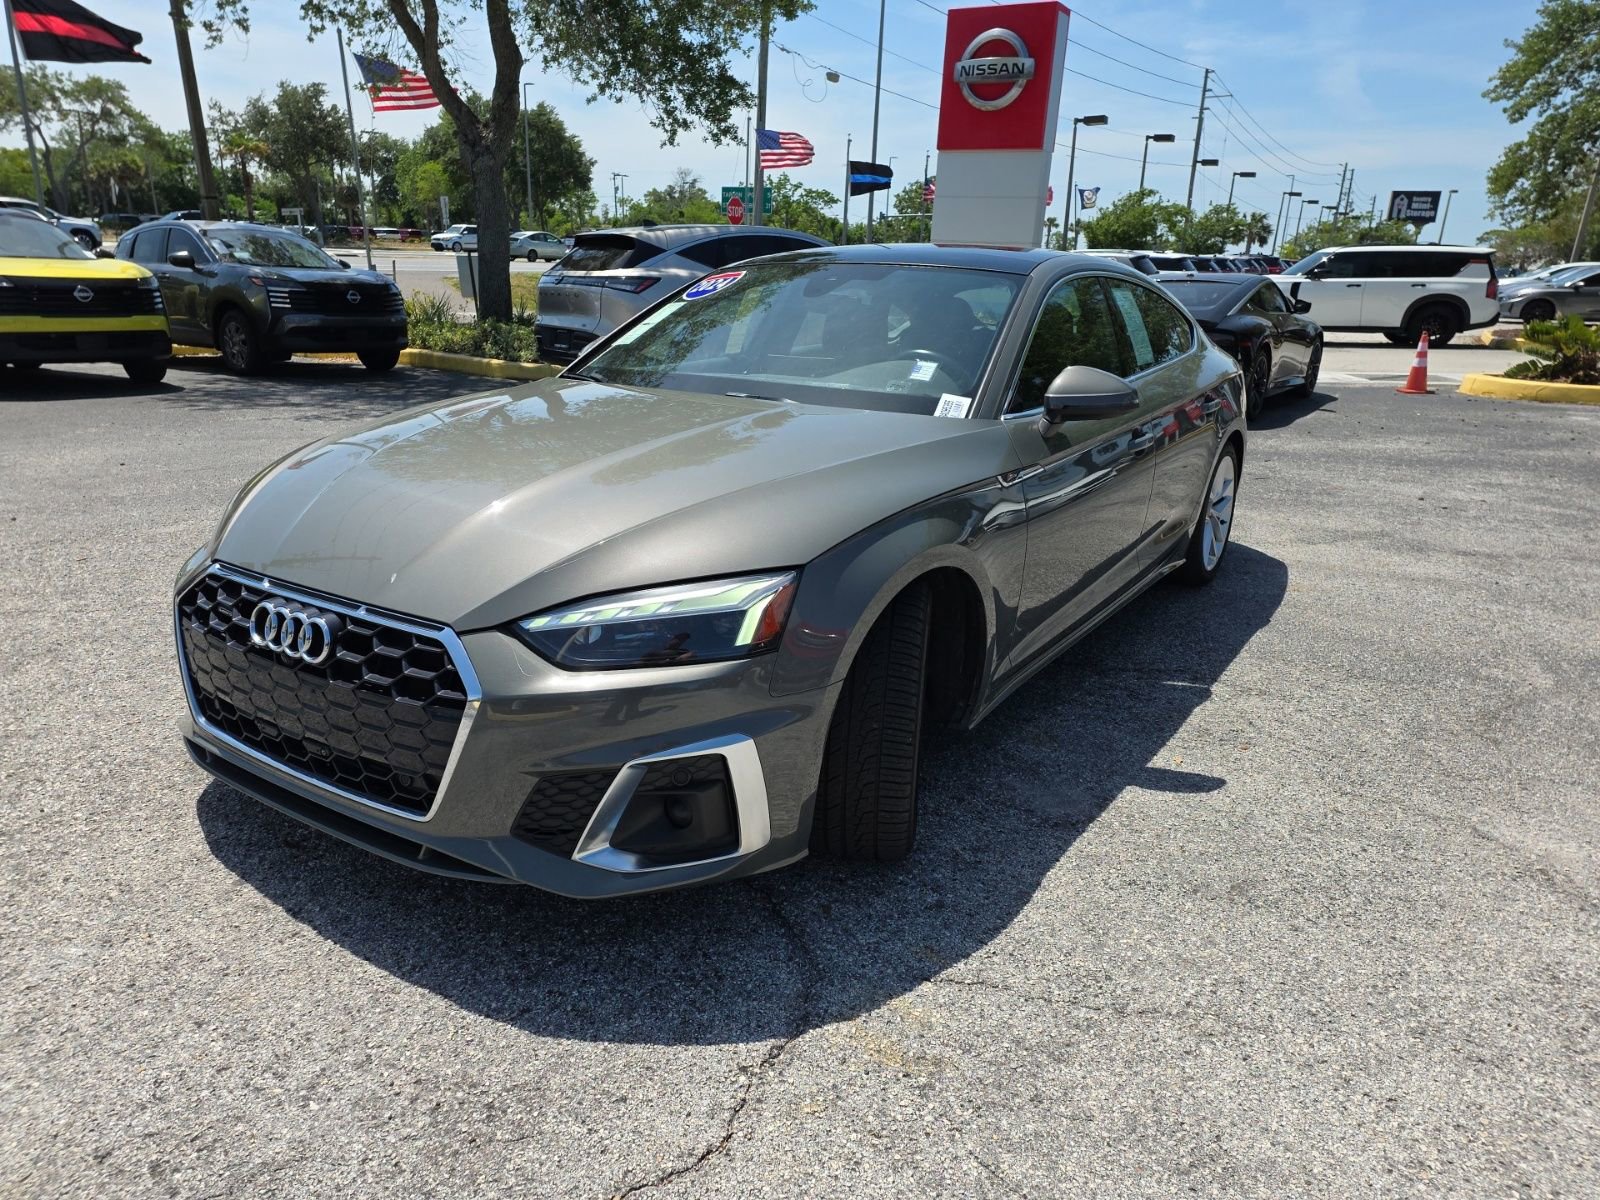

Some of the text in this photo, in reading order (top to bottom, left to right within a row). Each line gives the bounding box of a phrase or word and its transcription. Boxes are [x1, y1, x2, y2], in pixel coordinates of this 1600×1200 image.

[960, 62, 1025, 77] NISSAN
[728, 205, 743, 217] STOP
[1406, 209, 1435, 218] Storage
